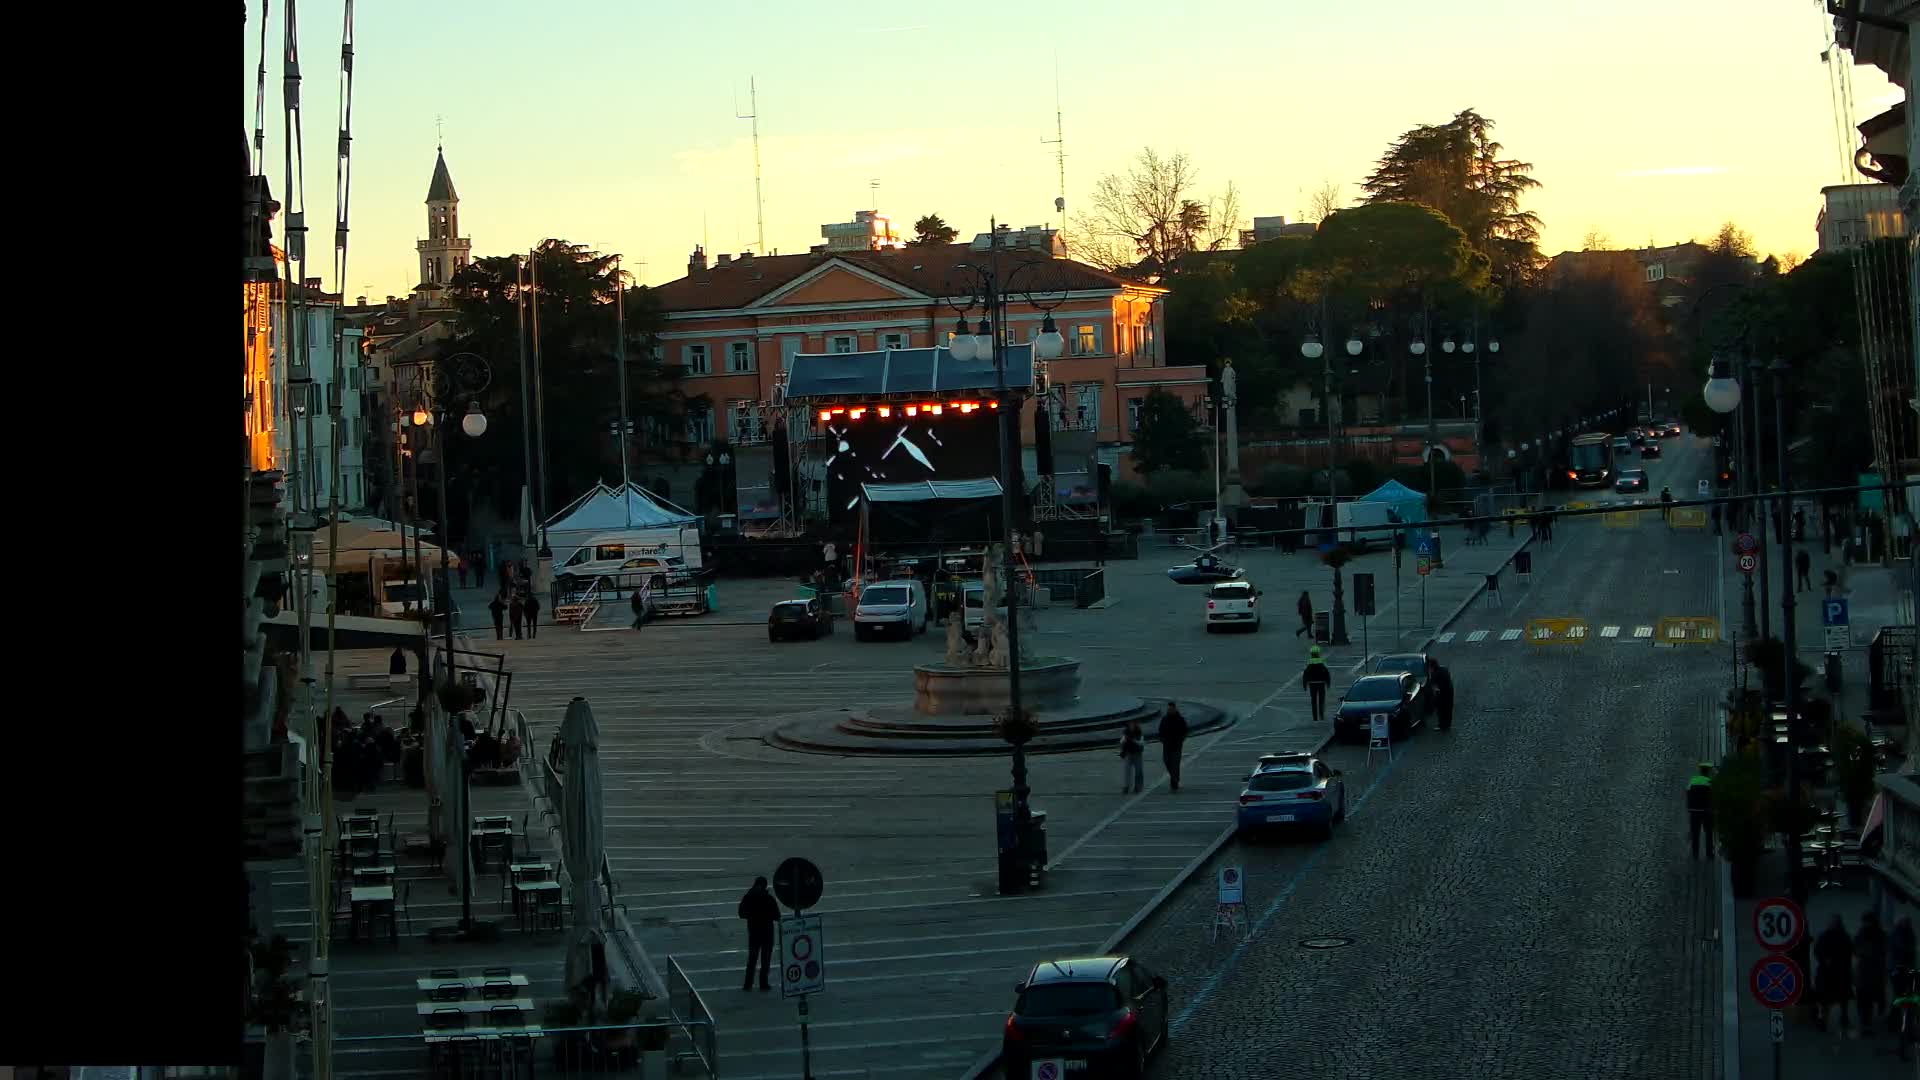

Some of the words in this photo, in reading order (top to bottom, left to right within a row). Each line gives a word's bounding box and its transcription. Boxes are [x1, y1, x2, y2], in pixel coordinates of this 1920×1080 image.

[1742, 558, 1754, 567] 20
[1827, 603, 1842, 621] P
[1763, 912, 1792, 938] 30
